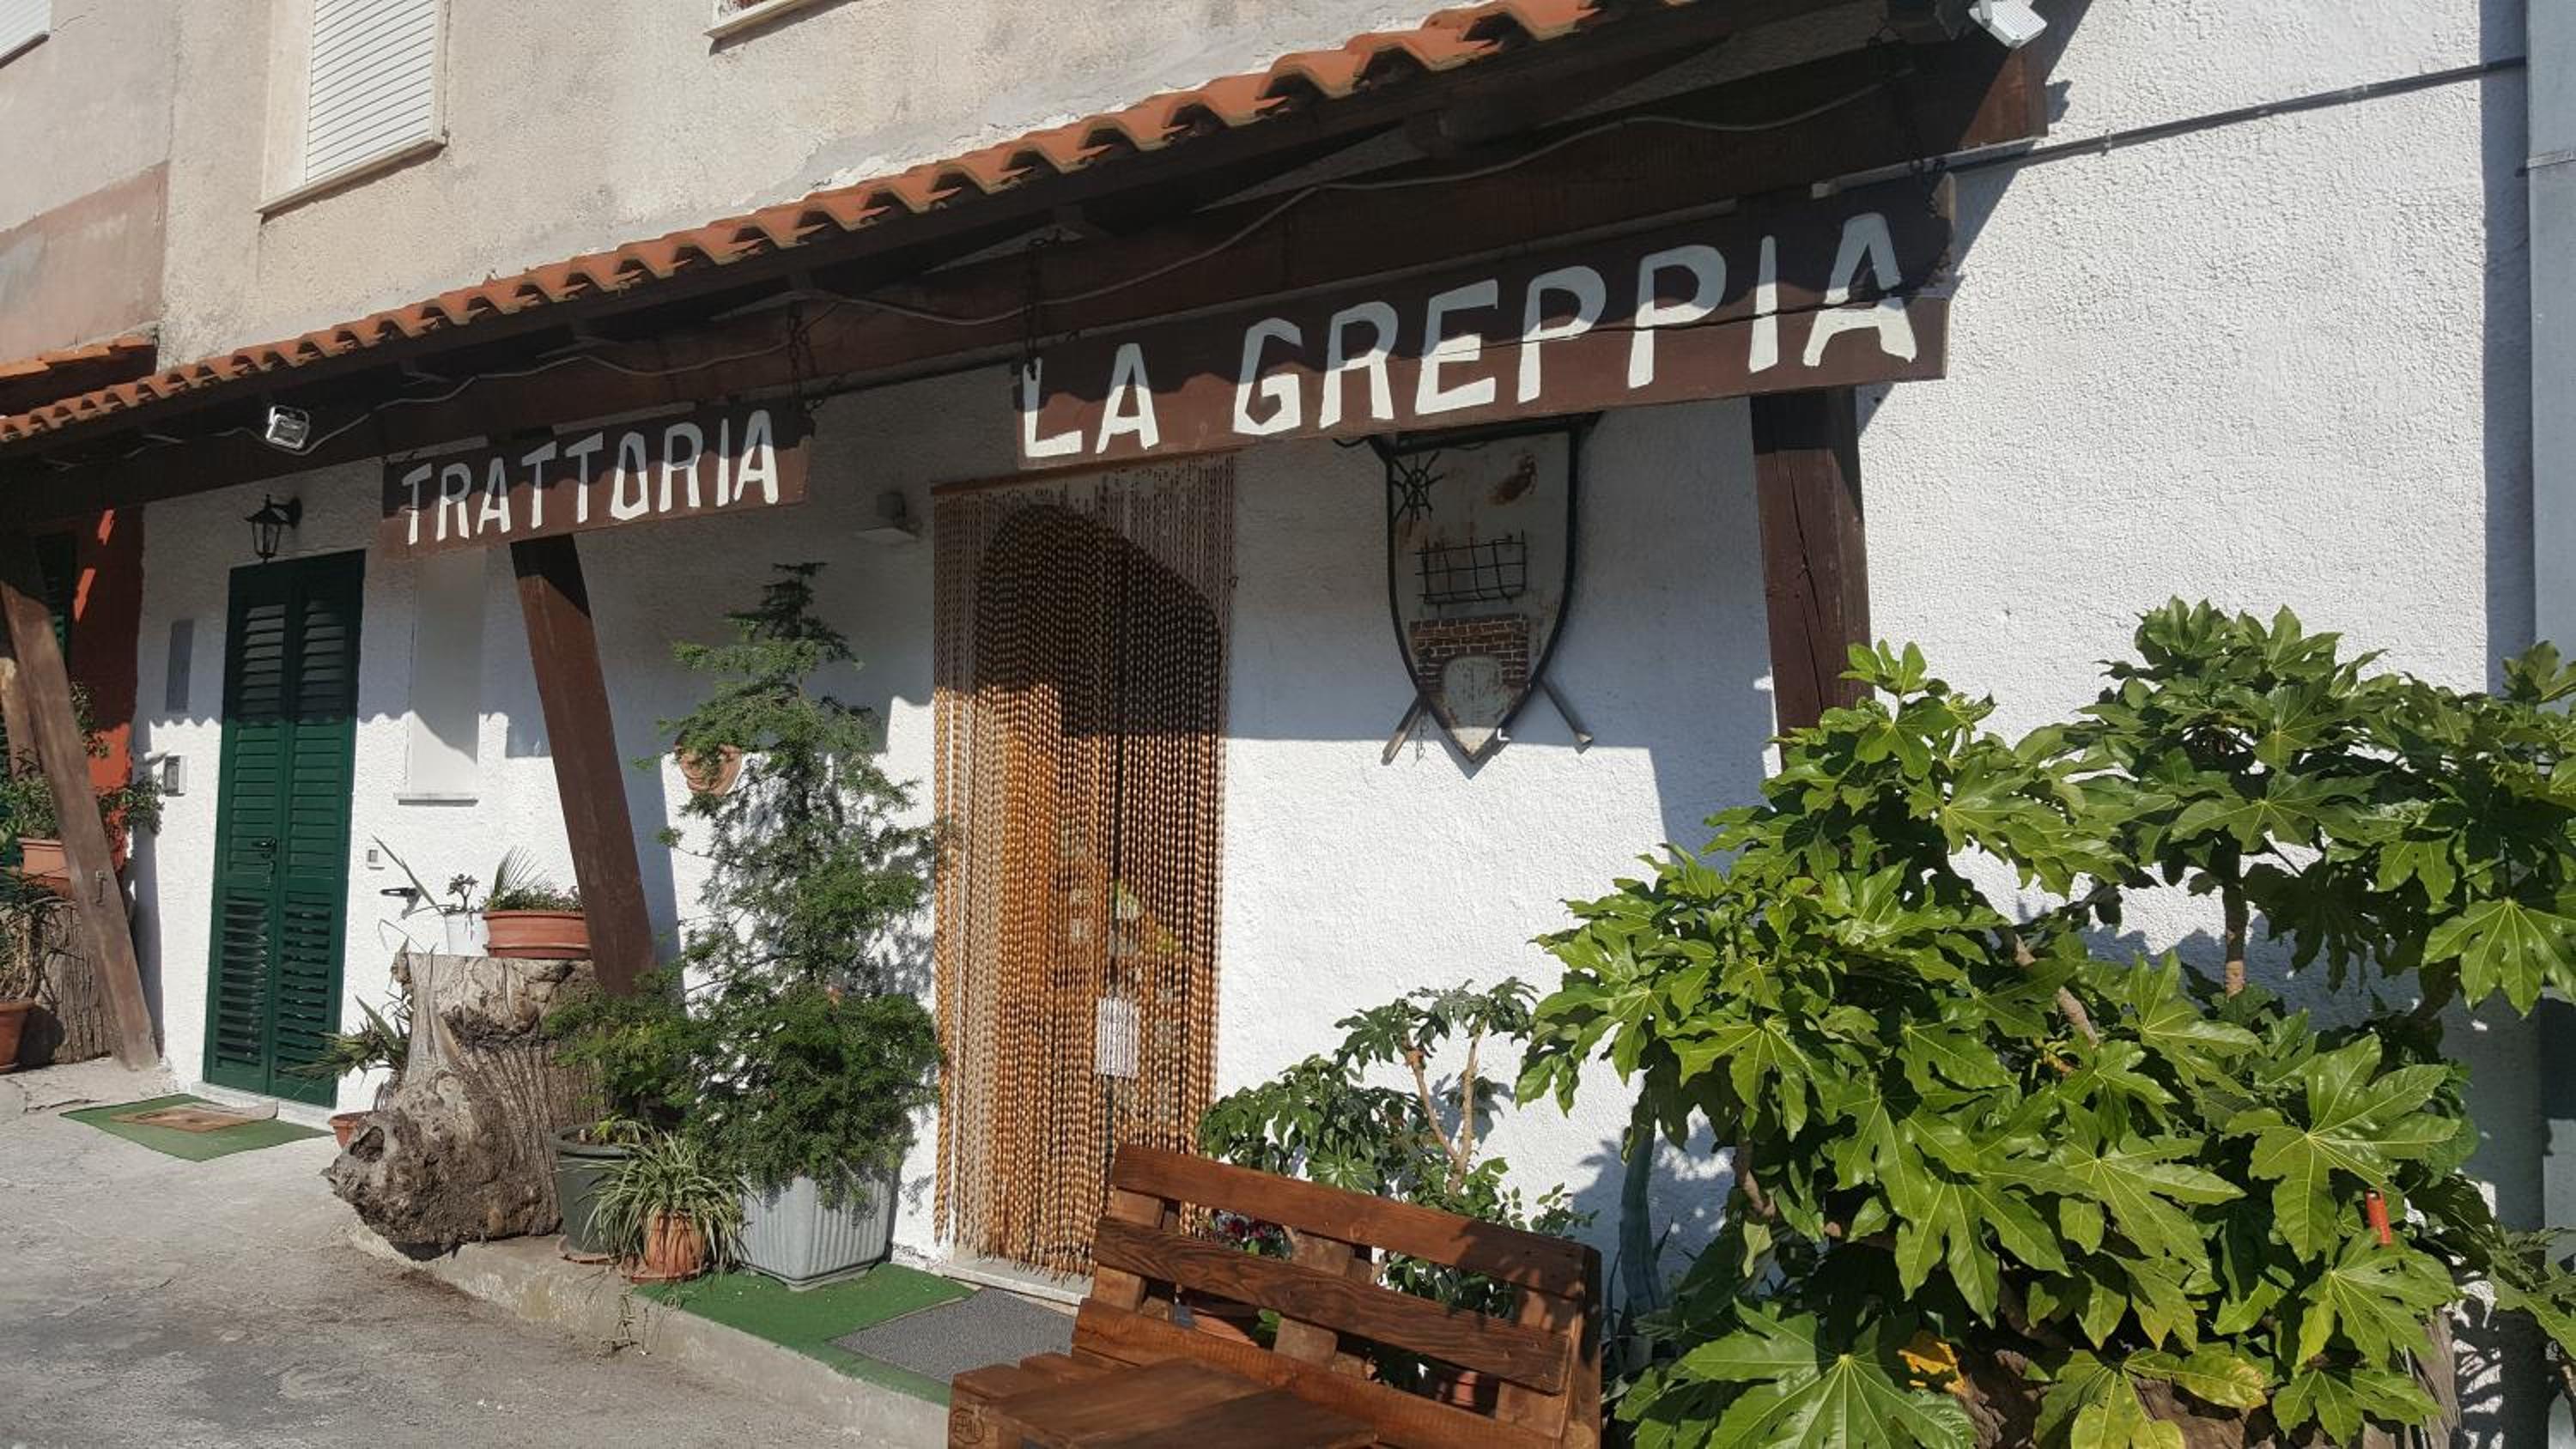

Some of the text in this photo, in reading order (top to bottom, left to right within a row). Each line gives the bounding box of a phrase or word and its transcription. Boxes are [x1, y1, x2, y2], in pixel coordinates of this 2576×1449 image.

[1023, 211, 1917, 458] LA GREPPIA
[401, 409, 779, 546] TRATTORIA
